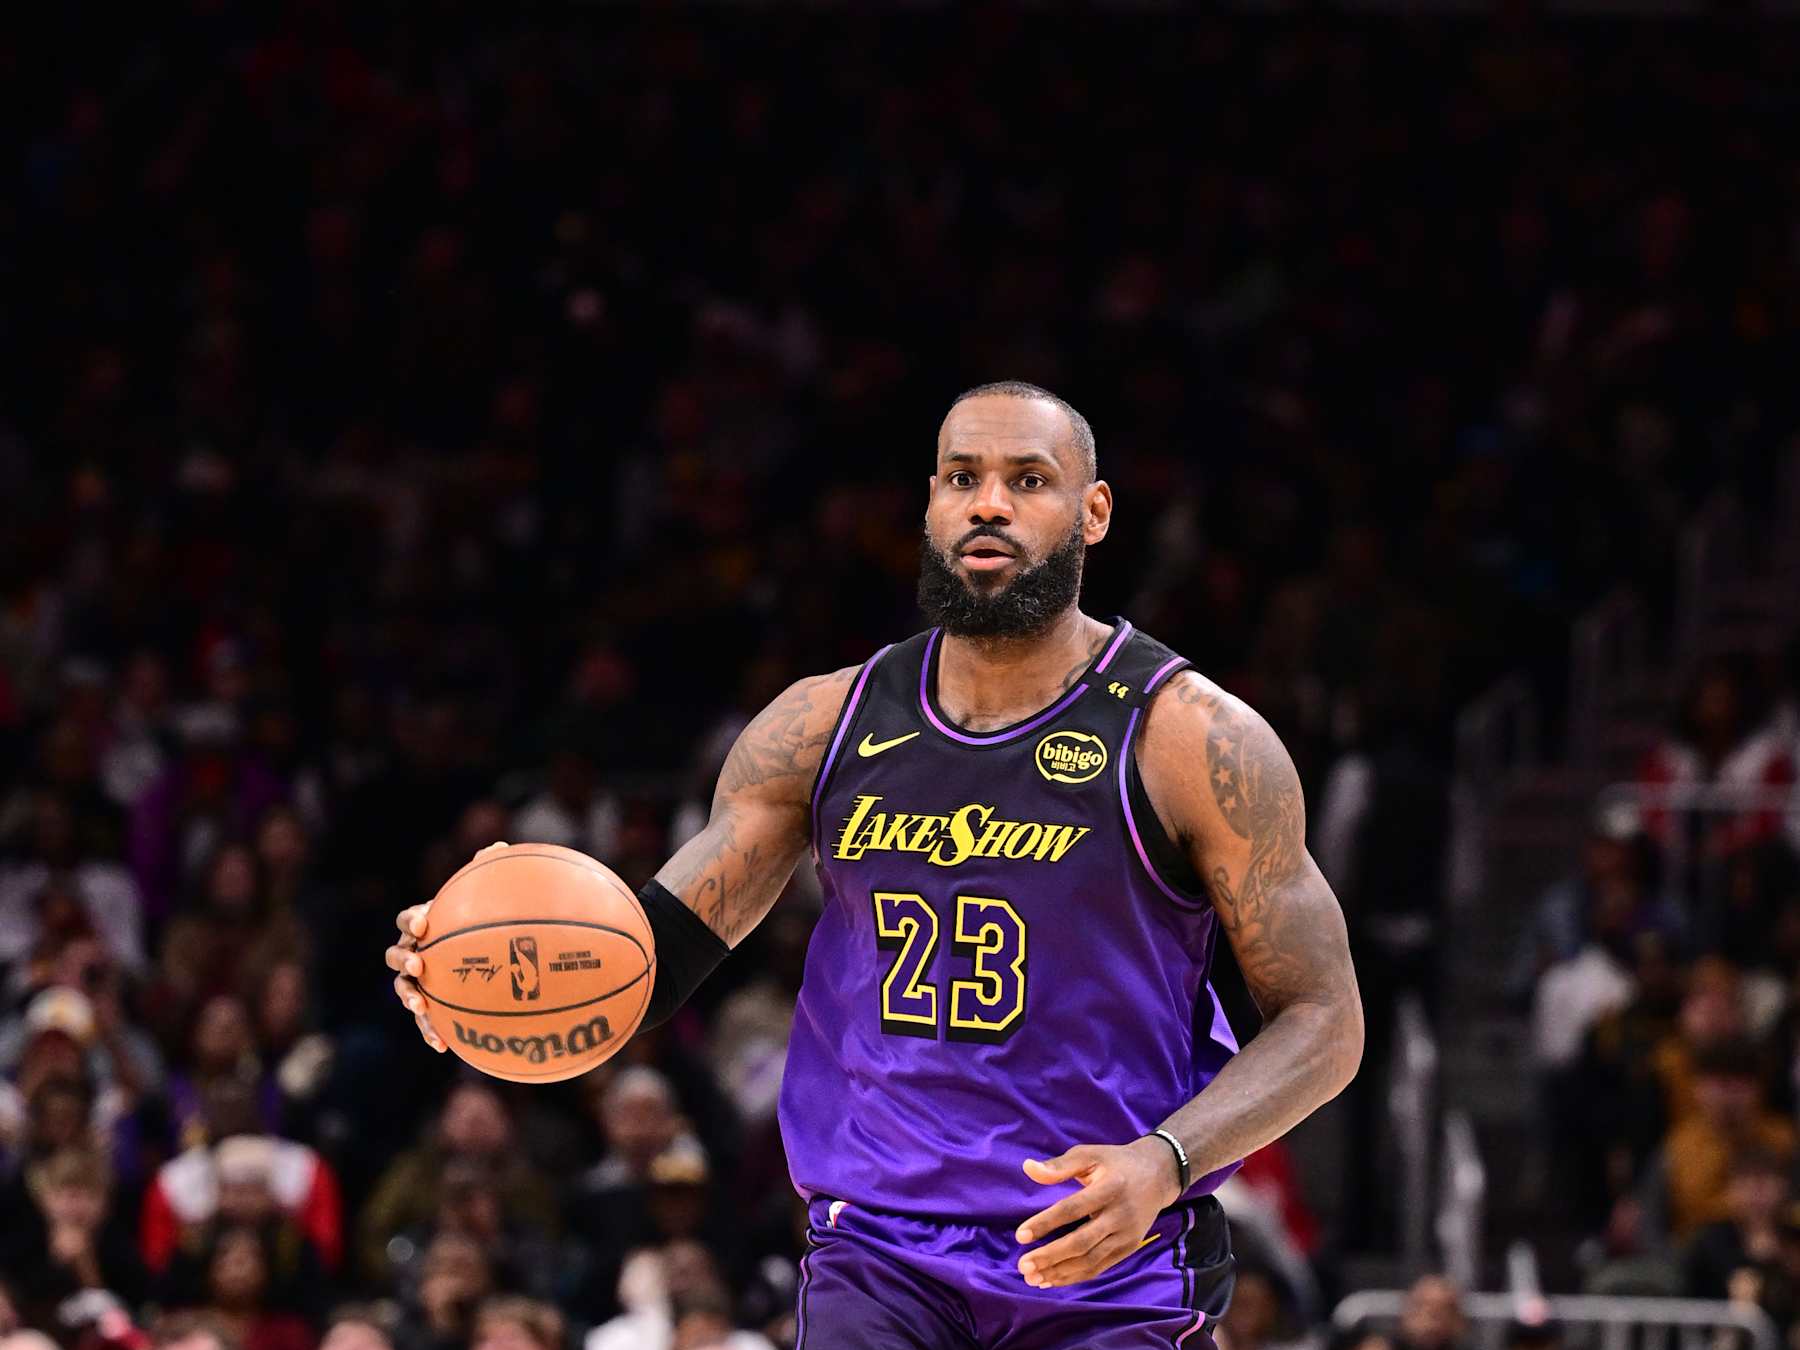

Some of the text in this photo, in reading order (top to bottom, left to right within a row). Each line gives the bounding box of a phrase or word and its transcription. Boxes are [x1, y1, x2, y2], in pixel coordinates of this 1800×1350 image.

[1107, 681, 1130, 699] 44
[1043, 743, 1103, 770] bibigo
[1051, 761, 1076, 772] 비비고
[873, 892, 1026, 1036] 23
[452, 1015, 615, 1063] Wilson
